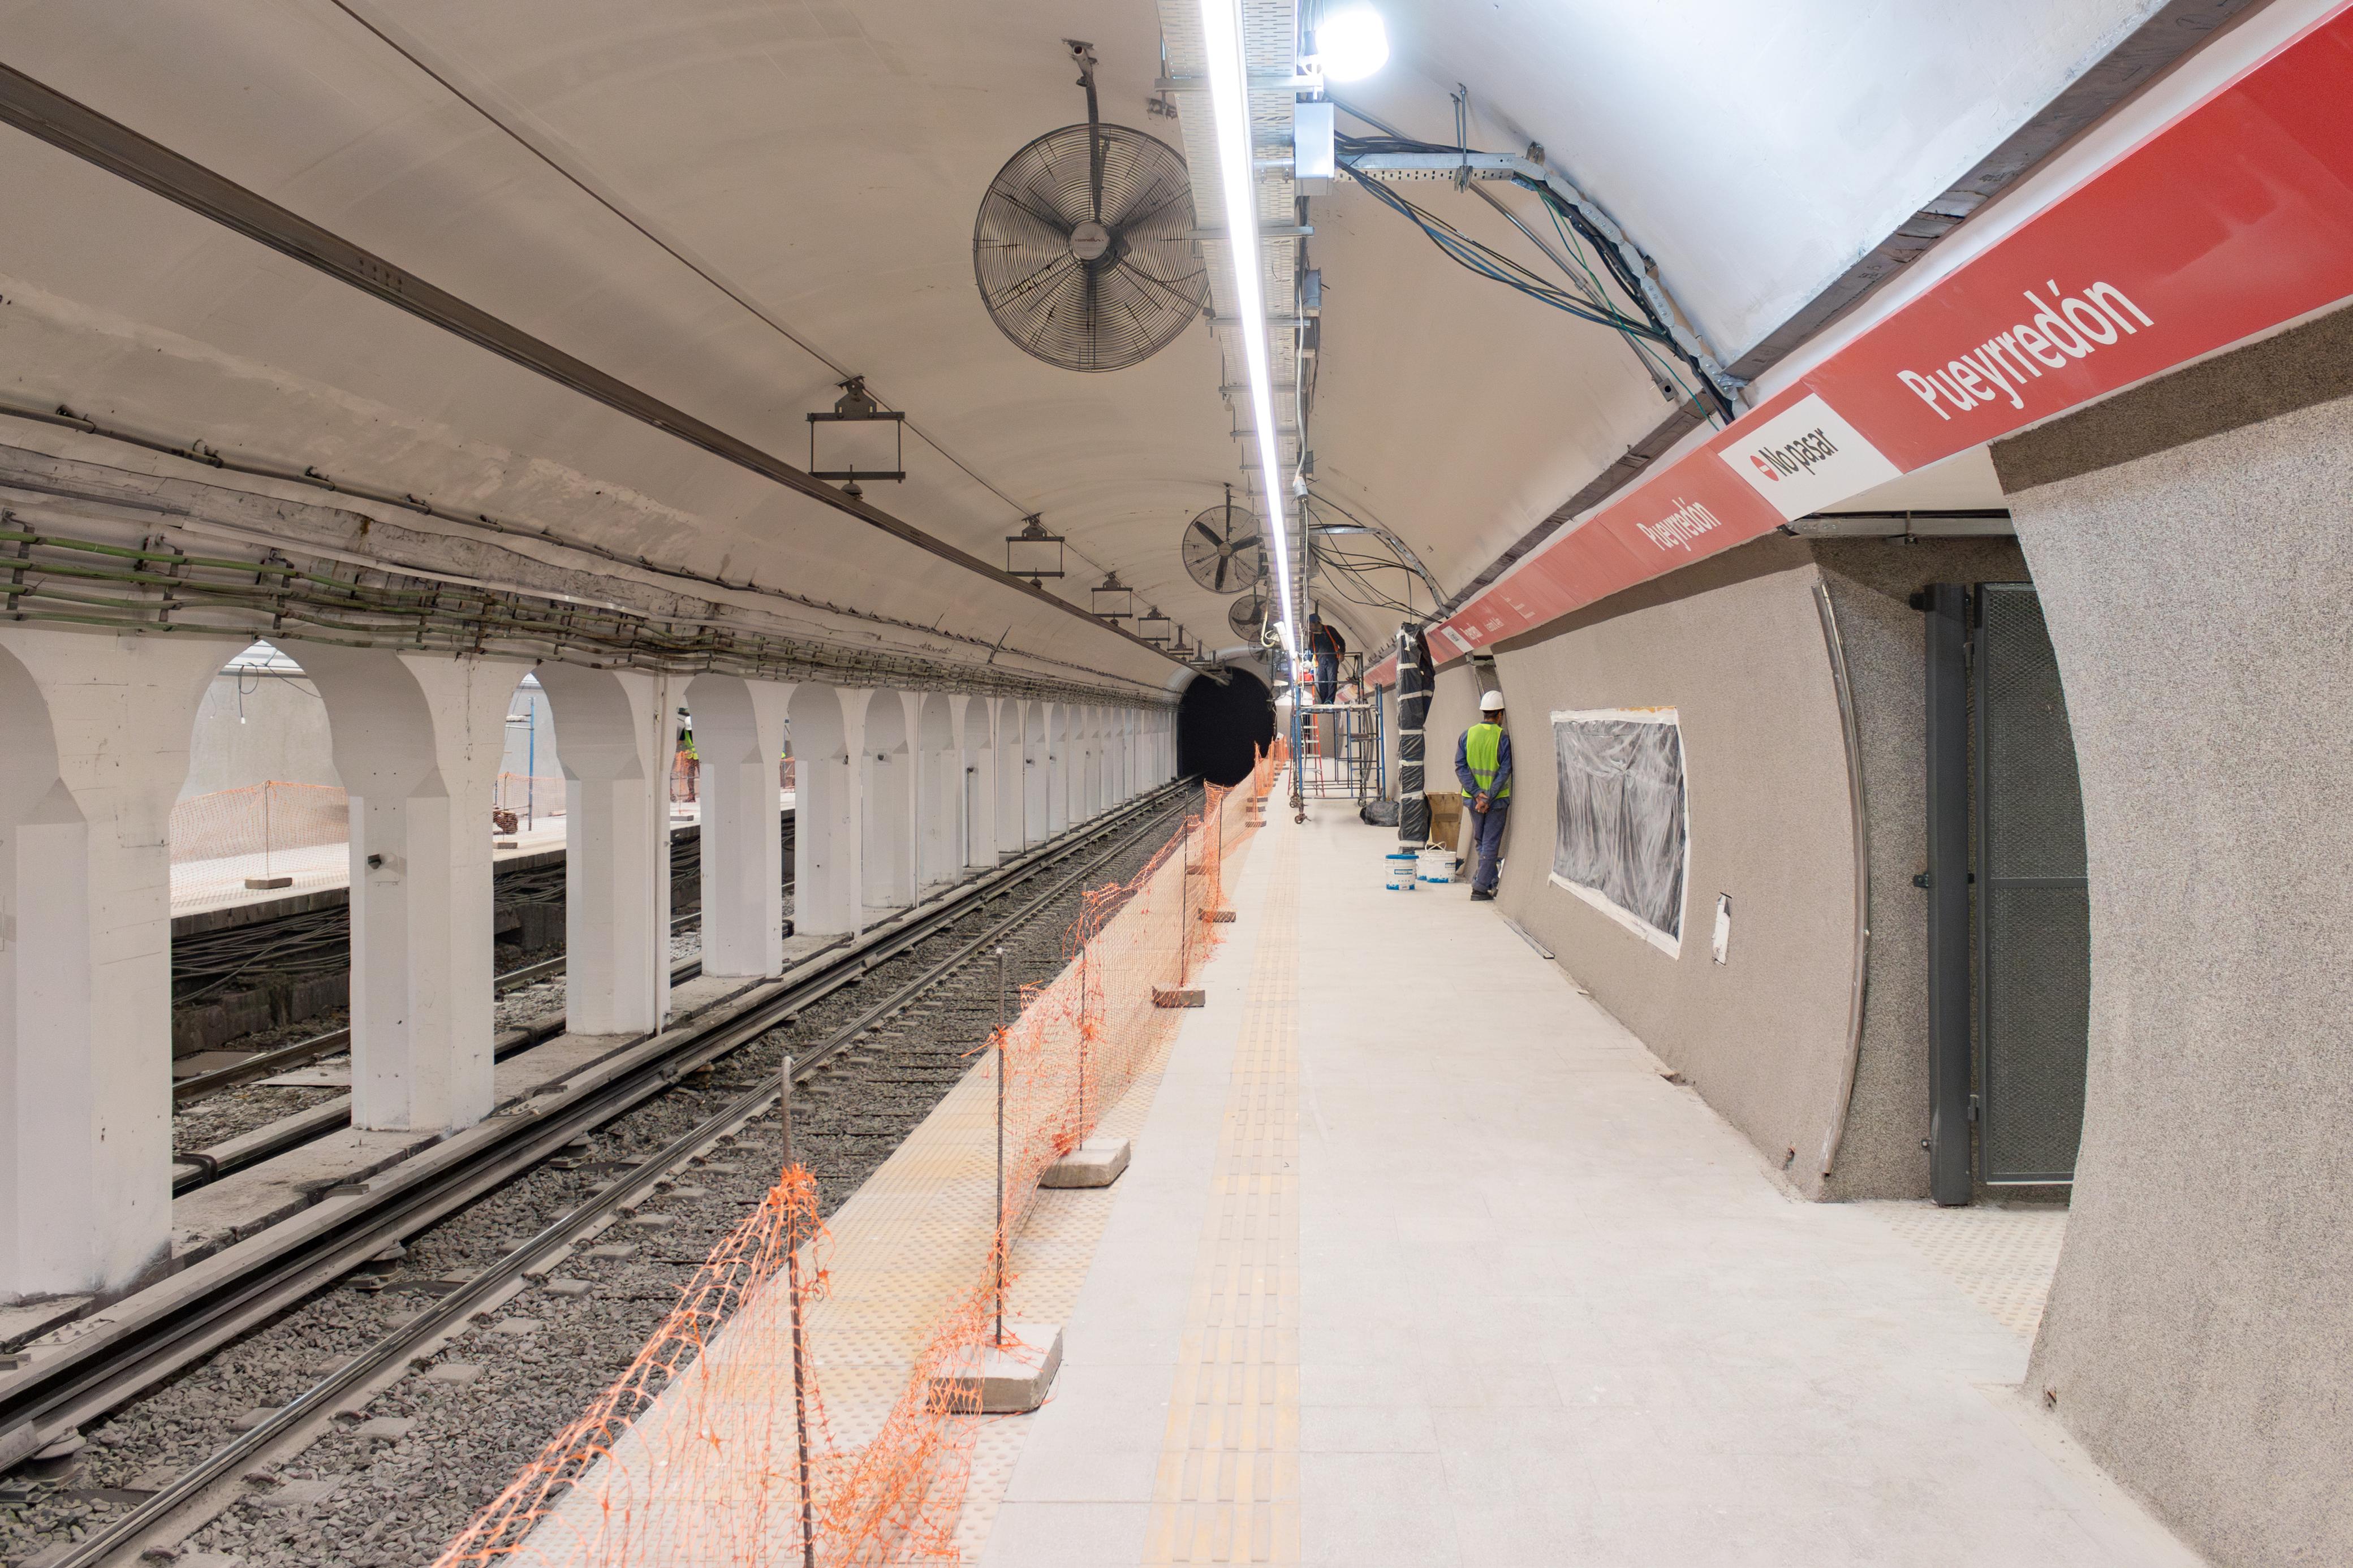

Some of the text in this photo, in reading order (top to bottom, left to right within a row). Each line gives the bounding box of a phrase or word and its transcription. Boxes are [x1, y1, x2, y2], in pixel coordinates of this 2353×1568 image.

[1896, 279, 2154, 420] Pueyrredón
[1758, 427, 1839, 477] No pasar
[1636, 496, 1722, 552] Pueyrredón
